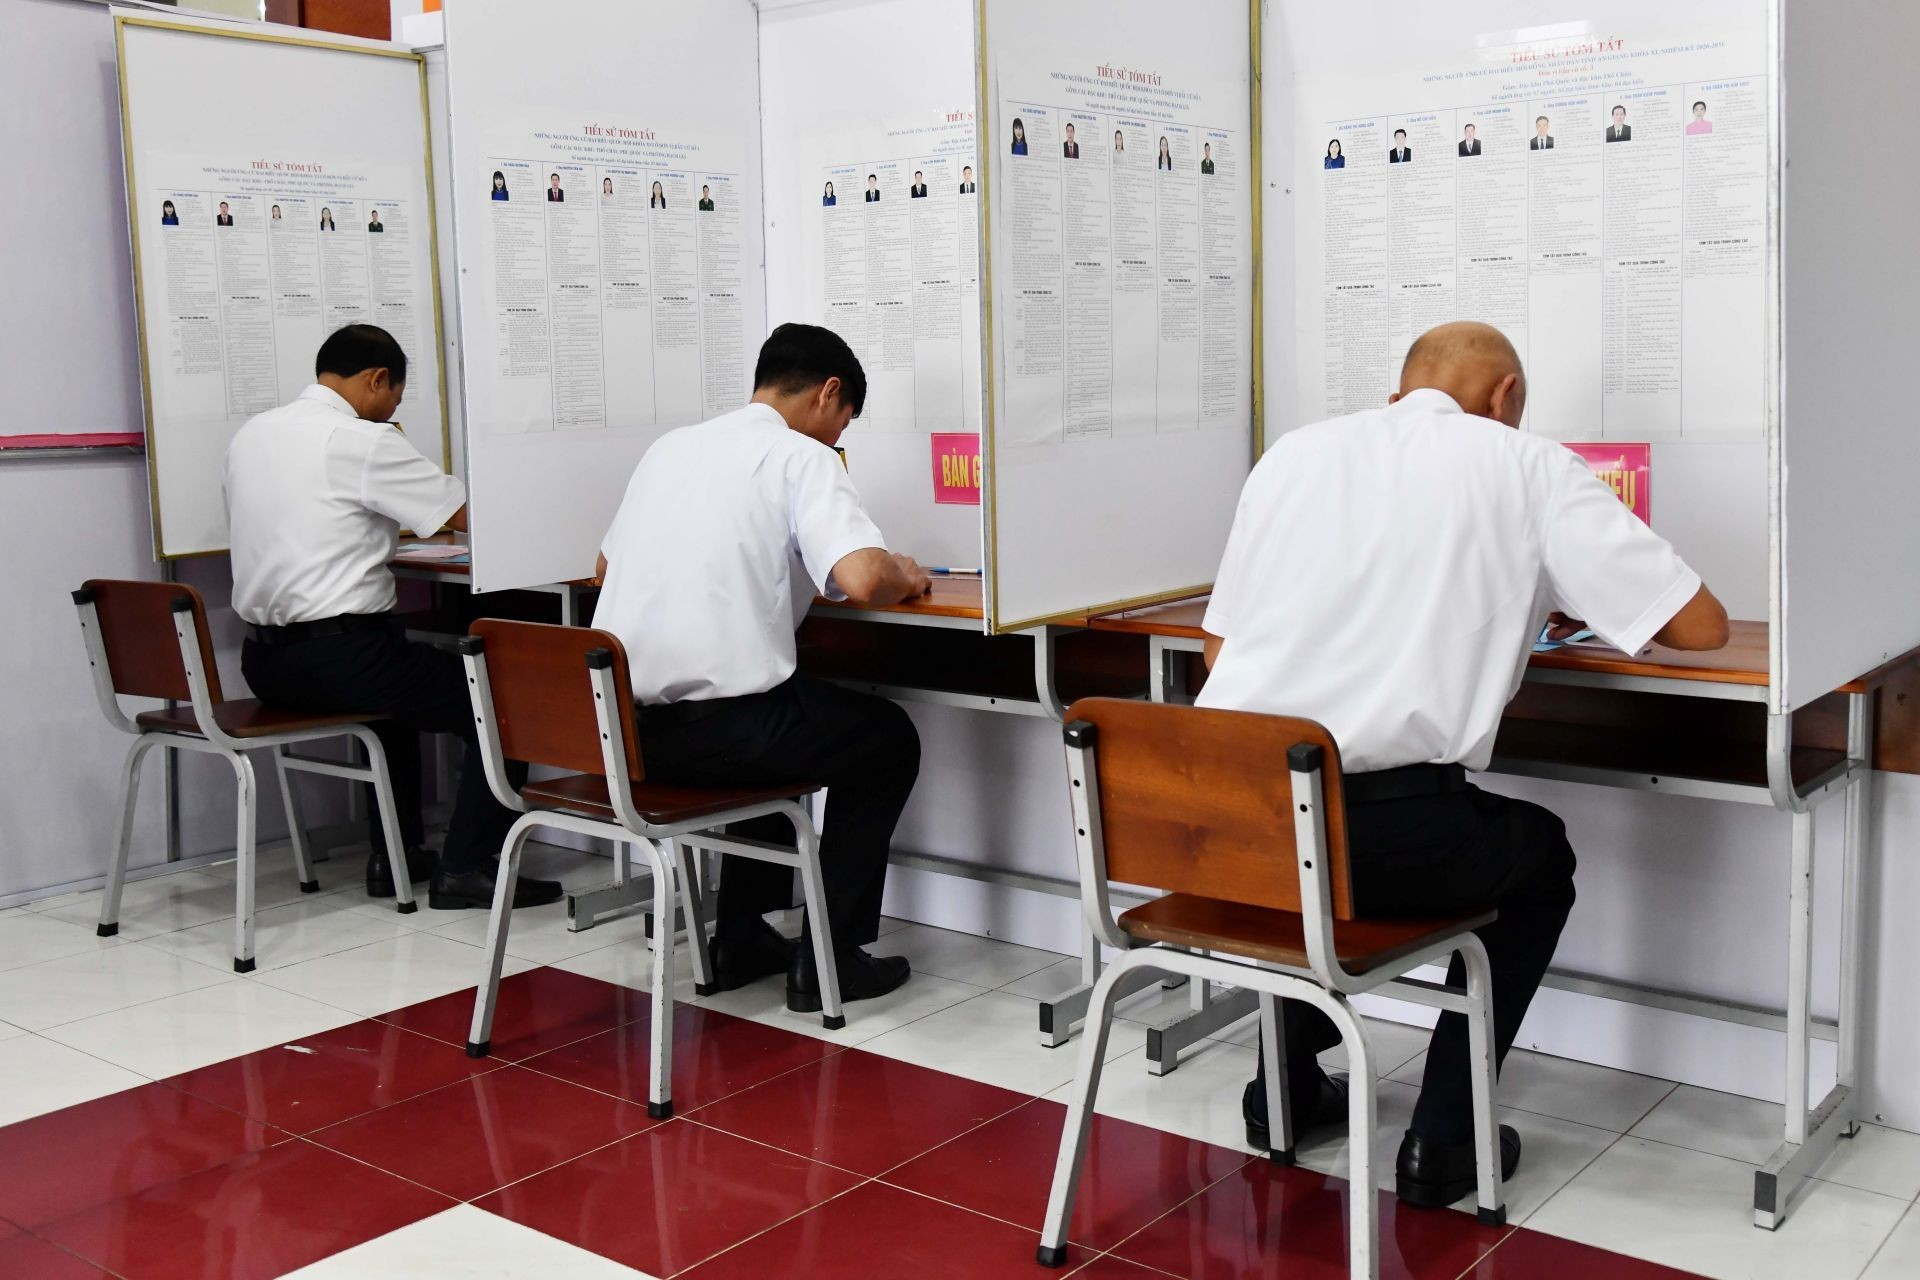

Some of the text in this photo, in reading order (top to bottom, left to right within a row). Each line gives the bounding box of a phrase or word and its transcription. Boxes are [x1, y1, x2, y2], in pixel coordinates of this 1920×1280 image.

[1511, 48, 1539, 63] TIỂU
[1598, 36, 1624, 53] TẮT
[1096, 62, 1162, 86] TIỂU SỬ TÓM TẮT
[946, 109, 965, 123] TIỂU
[584, 123, 656, 140] TIỂU SỬ TÓM TẮT
[251, 159, 323, 173] TIỂU SỬ TÓM TẮT
